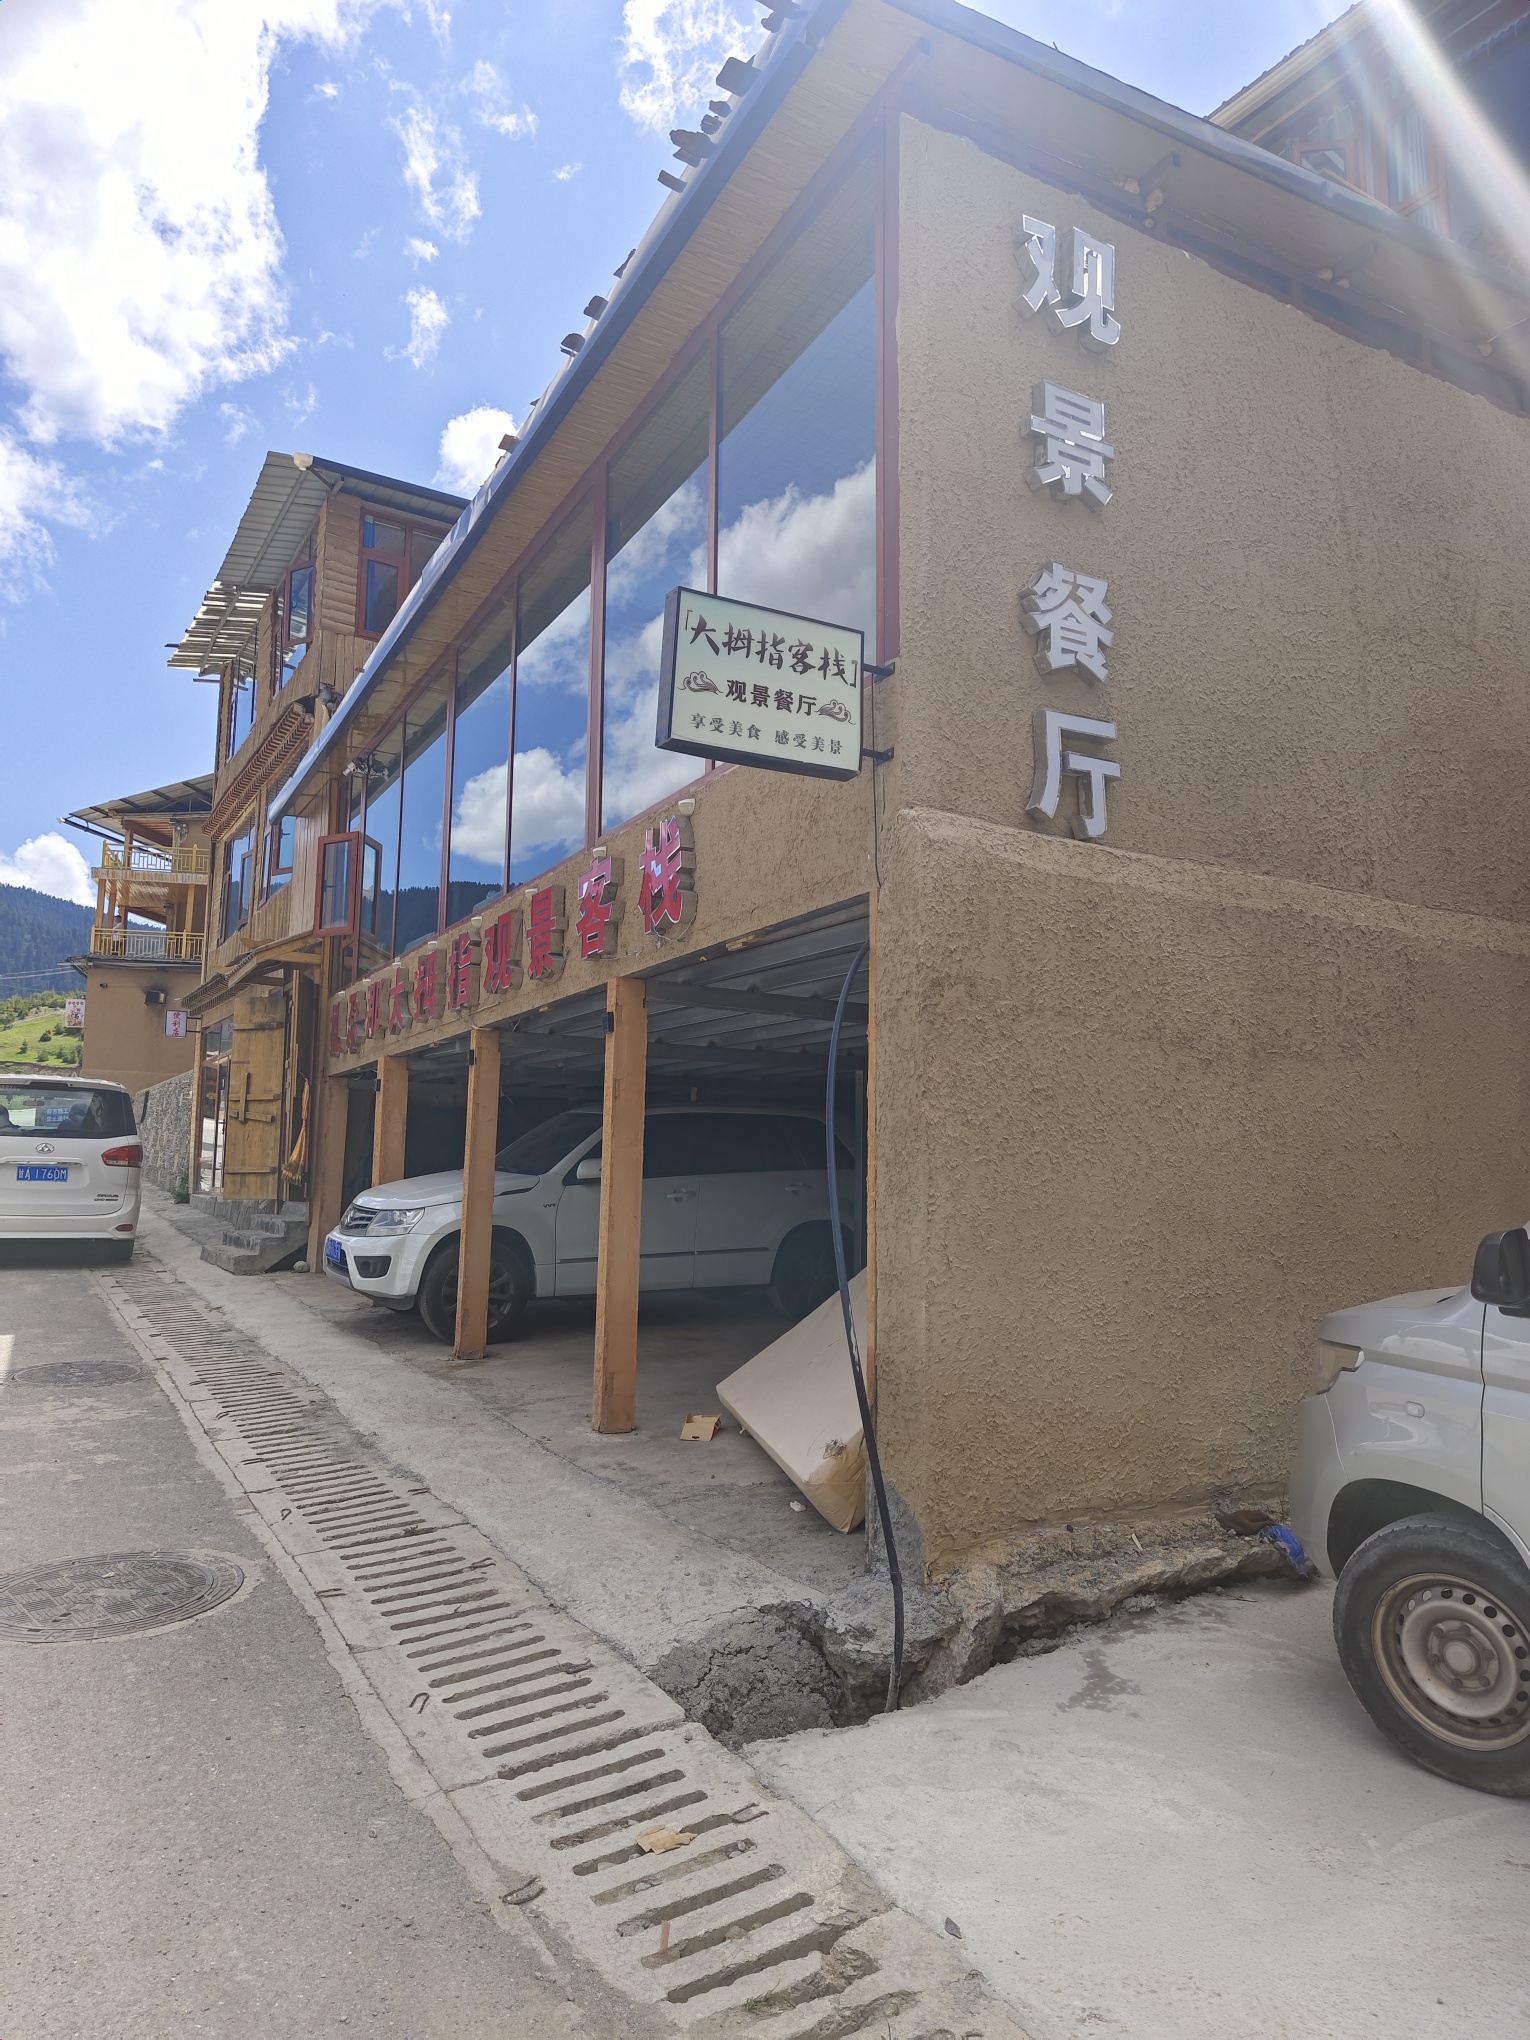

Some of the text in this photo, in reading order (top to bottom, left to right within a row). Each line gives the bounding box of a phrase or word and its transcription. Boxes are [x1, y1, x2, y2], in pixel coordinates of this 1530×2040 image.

[1019, 212, 1122, 838] 观景餐厅
[725, 679, 817, 716] 观景餐厅
[690, 712, 843, 755] 享受美食 感受美景
[171, 1011, 181, 1037] 便利店
